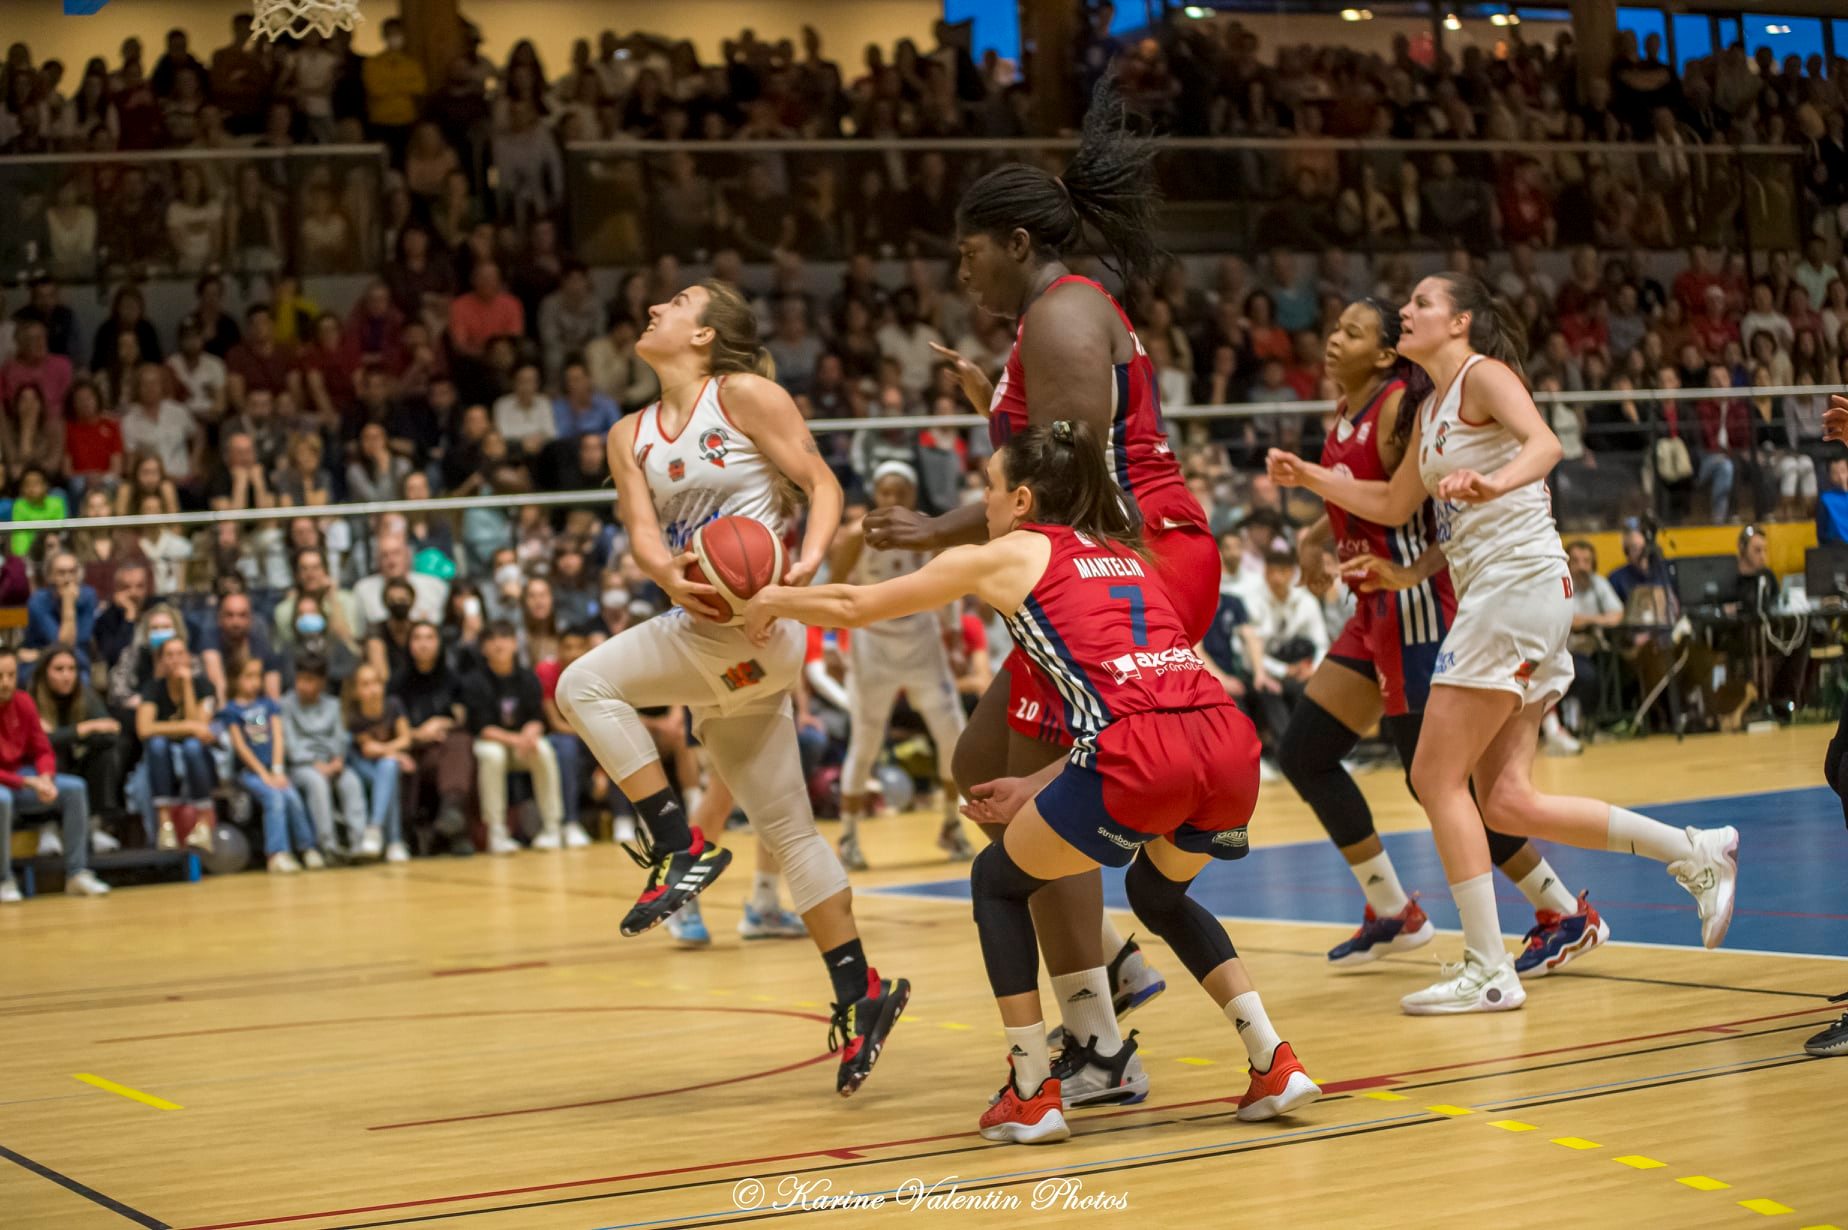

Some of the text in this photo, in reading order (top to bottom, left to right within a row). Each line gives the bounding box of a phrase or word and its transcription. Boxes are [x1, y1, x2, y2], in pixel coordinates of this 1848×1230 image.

[1073, 557, 1145, 579] MANTELIN
[1108, 584, 1149, 647] 7
[1015, 697, 1039, 721] 20
